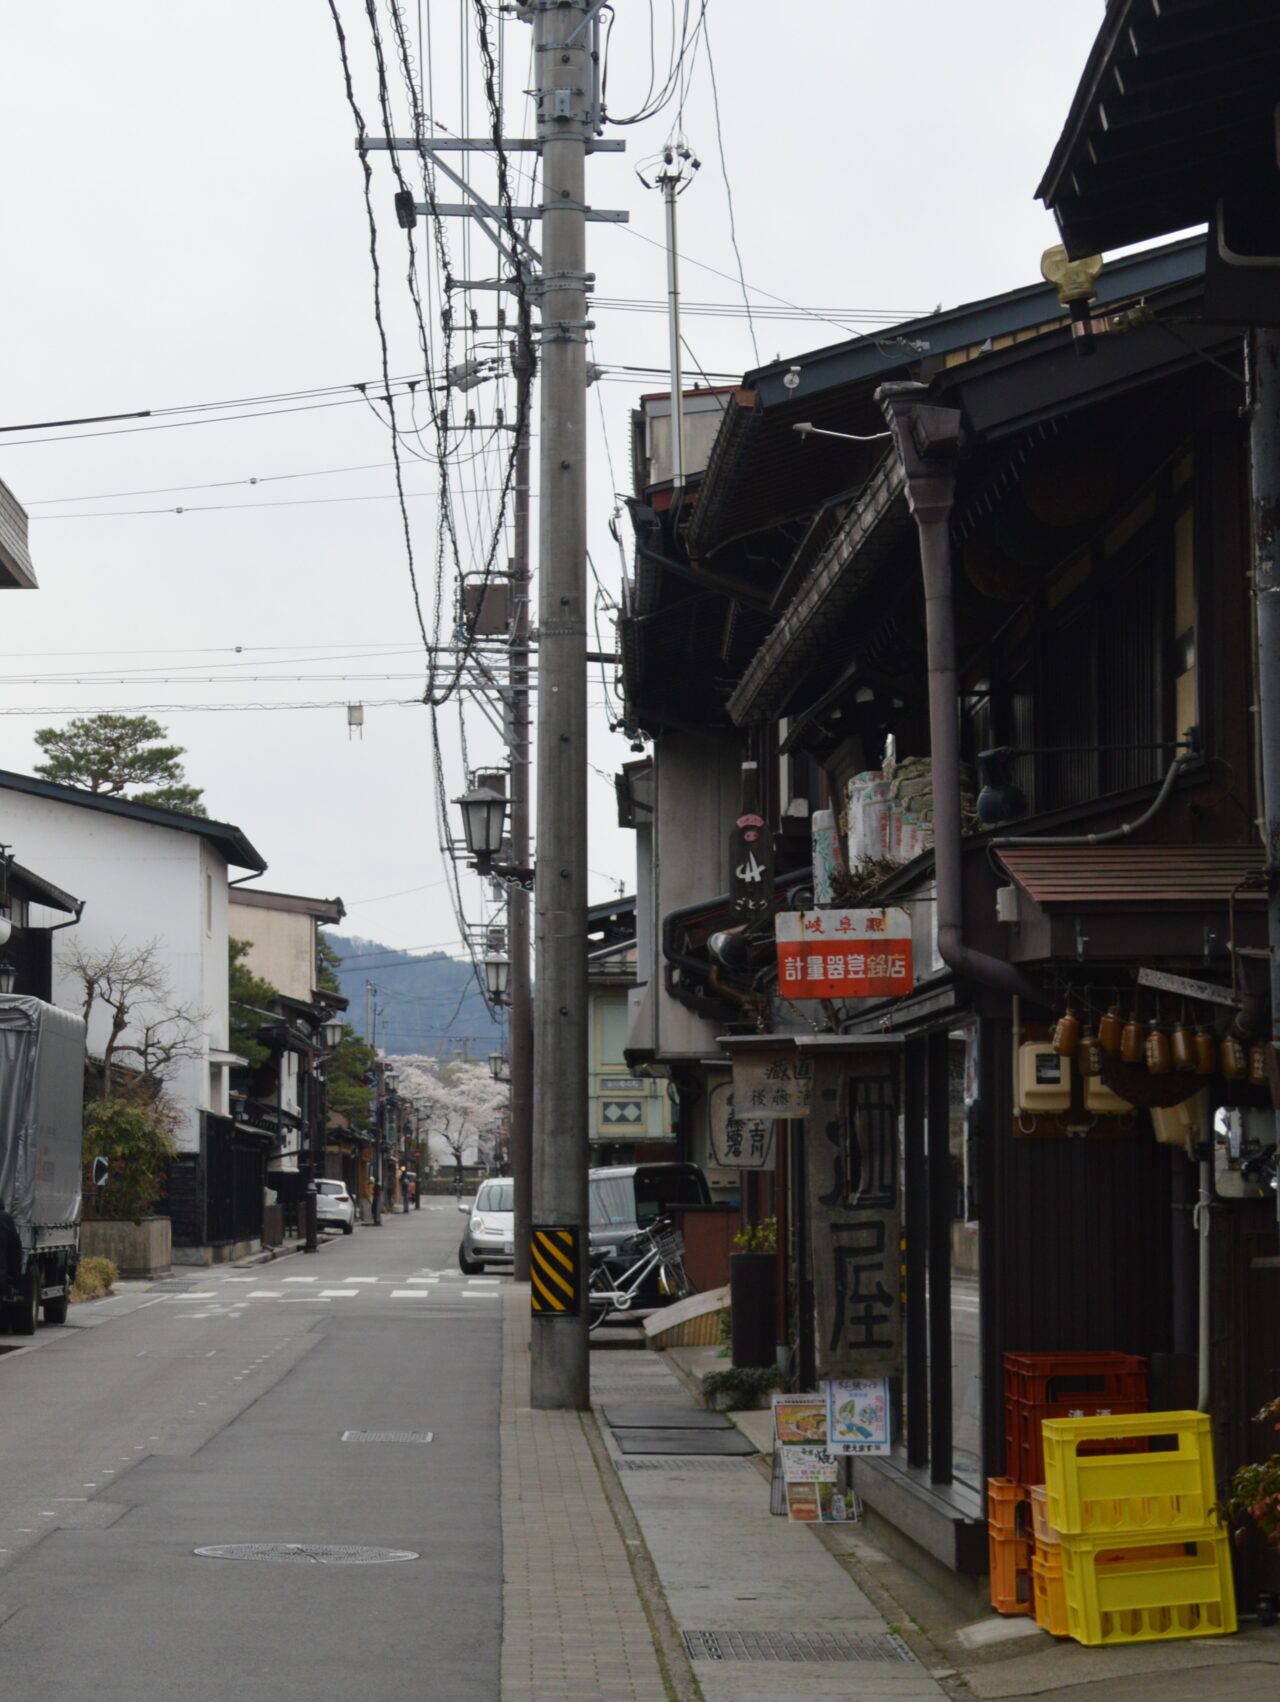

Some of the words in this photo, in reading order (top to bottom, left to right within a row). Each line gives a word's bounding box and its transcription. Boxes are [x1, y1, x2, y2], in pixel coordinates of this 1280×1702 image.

[734, 897, 769, 911] ごとう
[818, 1074, 896, 1352] 酒屋
